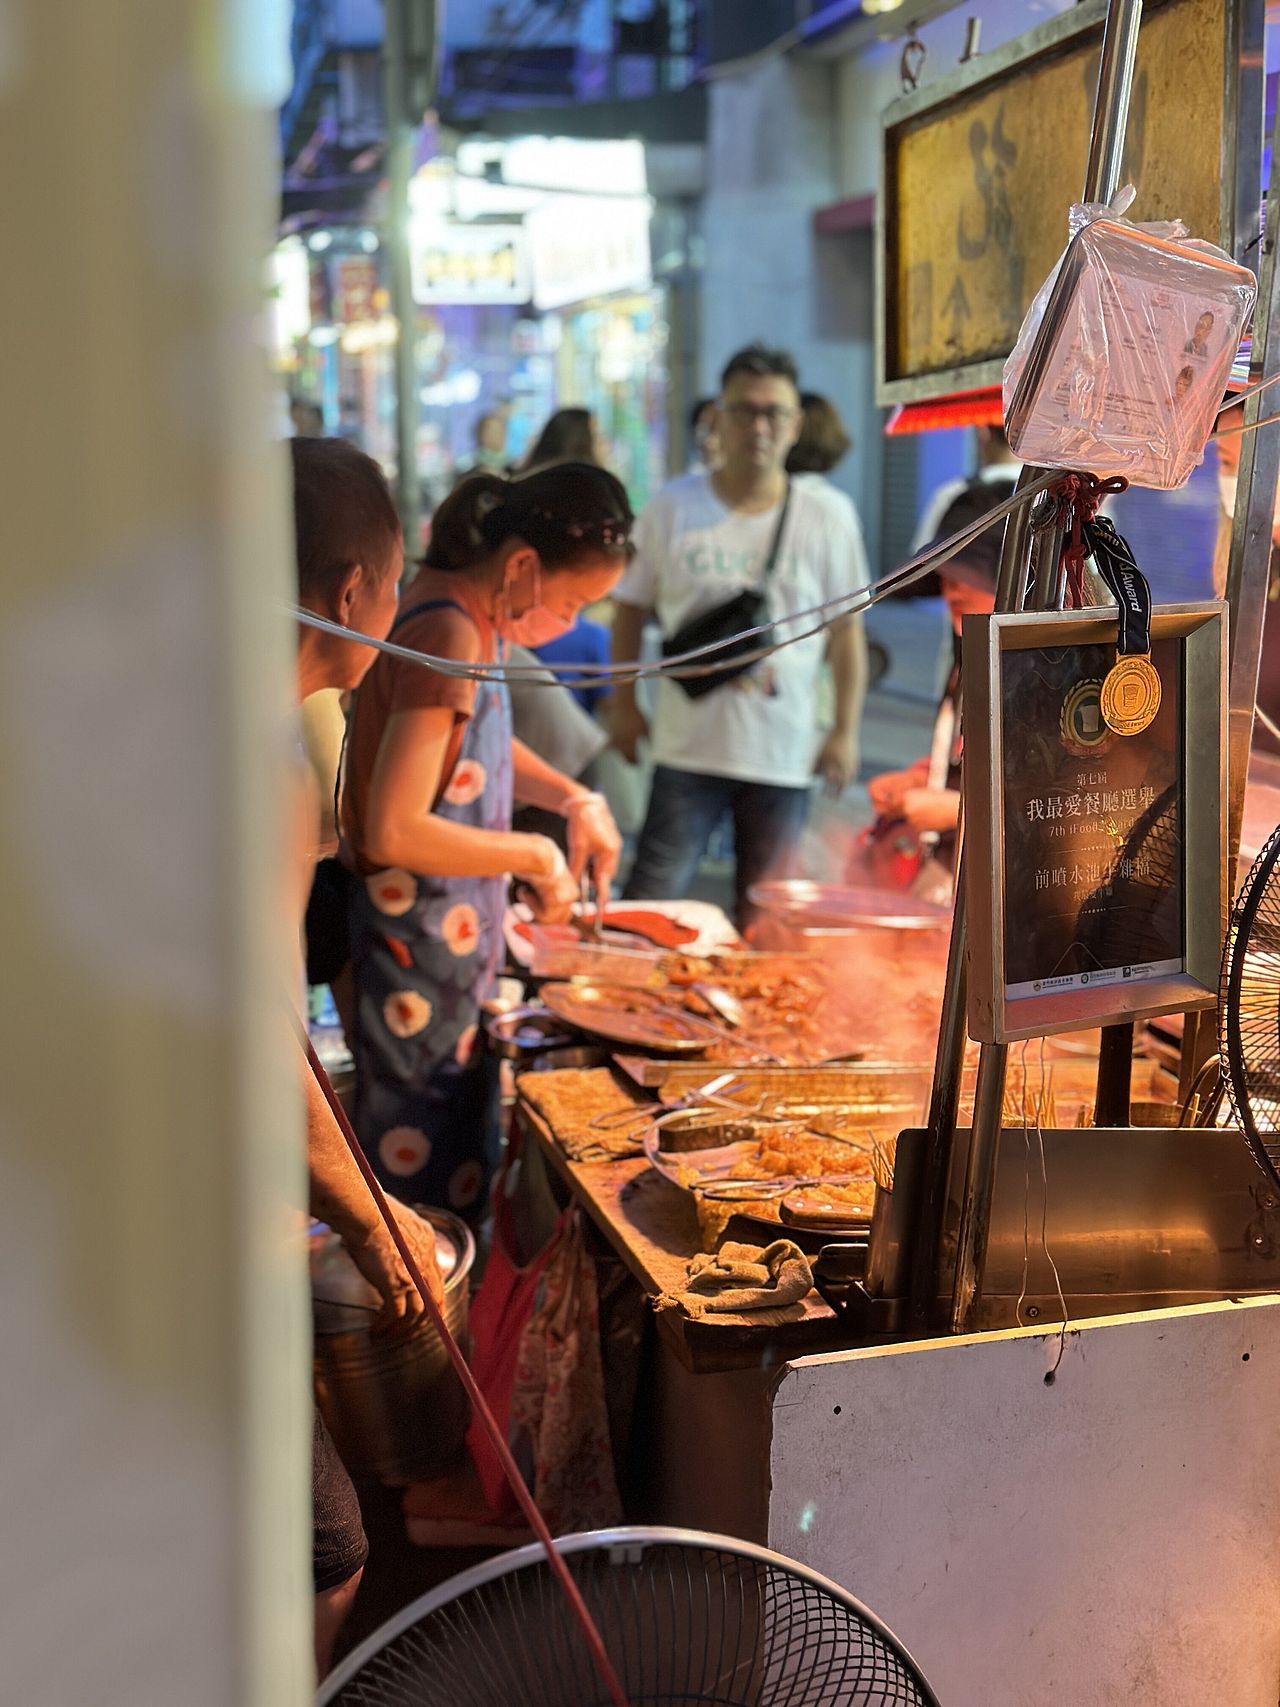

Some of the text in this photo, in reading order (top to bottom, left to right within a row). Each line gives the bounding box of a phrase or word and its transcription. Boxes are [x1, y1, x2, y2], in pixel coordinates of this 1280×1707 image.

[686, 545, 798, 577] GUCI
[1120, 571, 1143, 612] Award
[1076, 771, 1108, 787] 第七屆
[1026, 786, 1155, 822] 我最愛餐廳選舉
[1049, 825, 1066, 838] 7th
